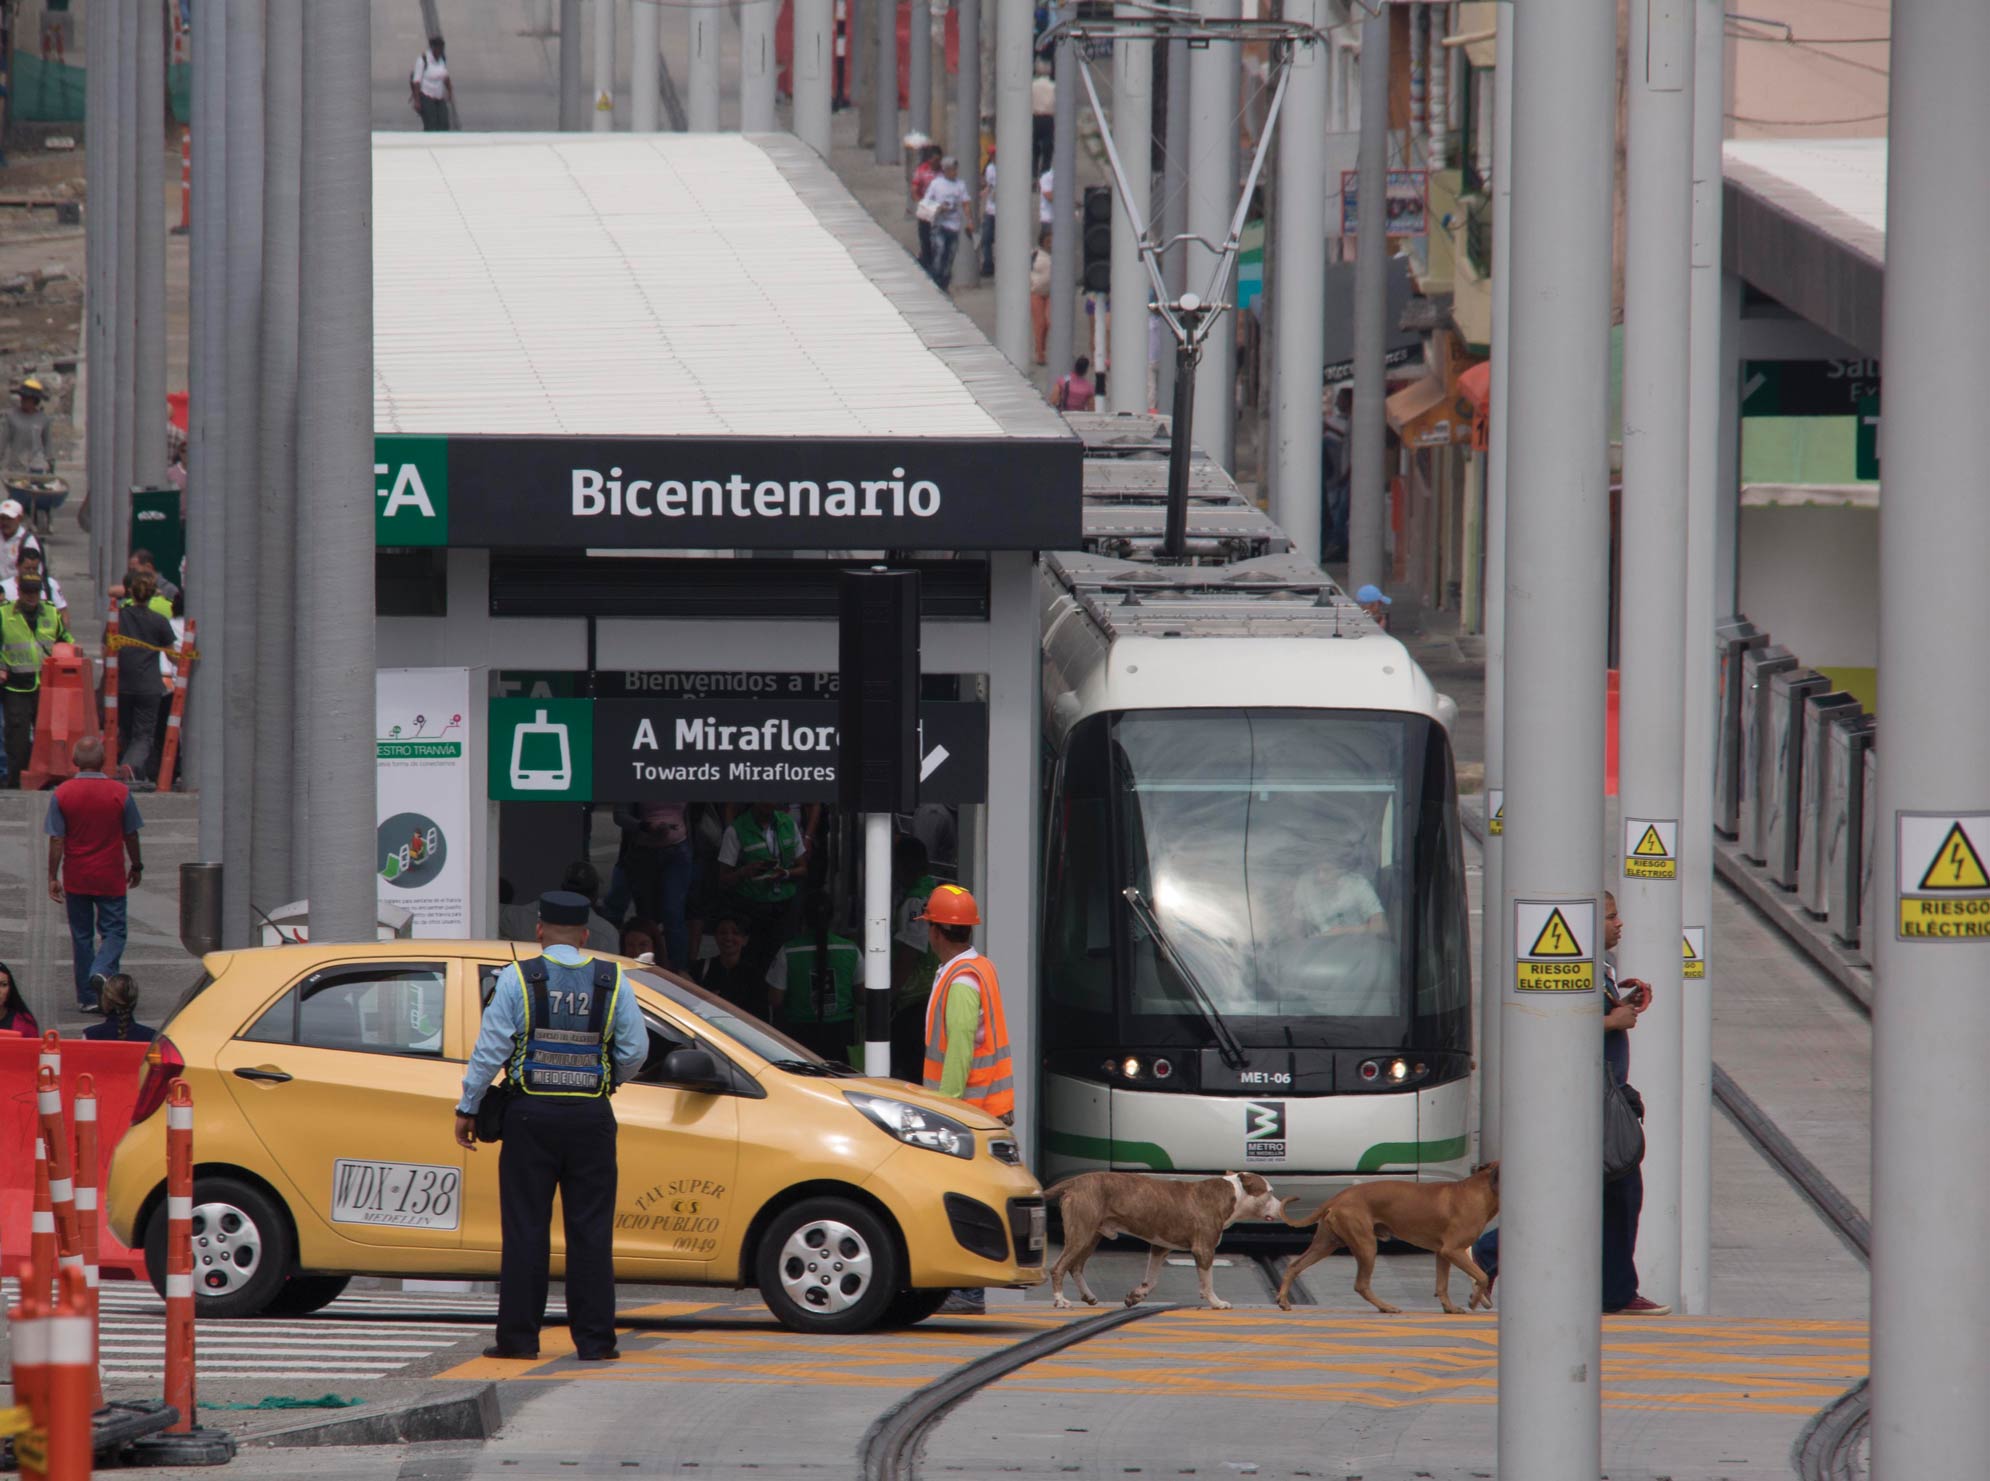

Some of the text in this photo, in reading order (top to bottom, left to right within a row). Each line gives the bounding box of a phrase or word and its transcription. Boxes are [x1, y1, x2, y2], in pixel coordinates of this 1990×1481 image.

[571, 466, 941, 517] Bicentenario
[625, 671, 777, 691] Bienvenidos
[788, 674, 802, 691] a
[632, 716, 840, 751] A Miraflor
[376, 745, 411, 755] ESTRO
[632, 762, 836, 781] Towards Miraflores
[1633, 859, 1667, 868] RIESGO
[1921, 901, 1990, 915] RIESGO
[1905, 919, 1990, 936] ELÉCTRIC
[1530, 964, 1581, 975] RIESGO
[1520, 977, 1591, 989] ELÉCTRICO
[549, 990, 591, 1016] 712
[1241, 1071, 1292, 1084] ME1-06
[1248, 1143, 1284, 1151] METRO
[668, 1179, 726, 1200] SUPER
[615, 1214, 720, 1233] ICIO PUBLICO
